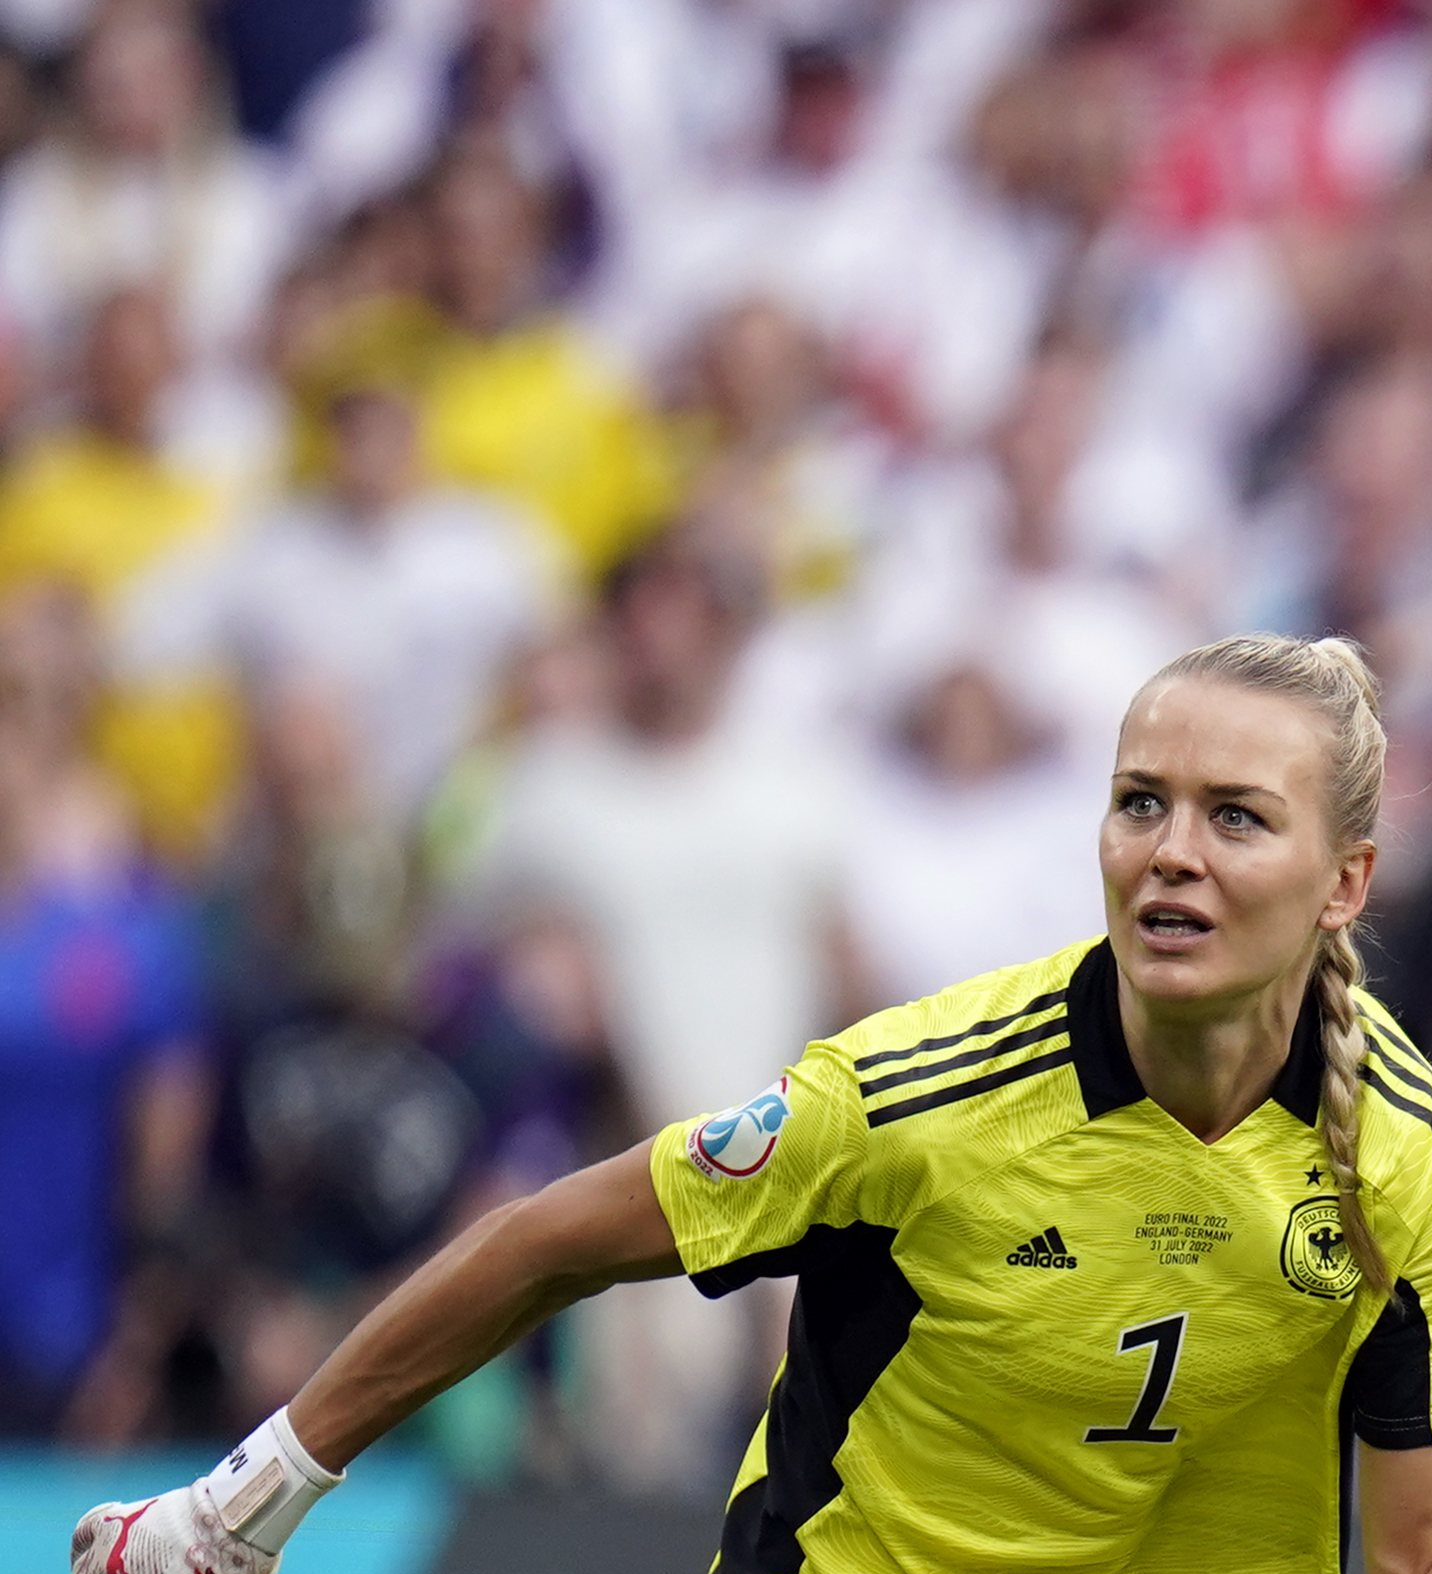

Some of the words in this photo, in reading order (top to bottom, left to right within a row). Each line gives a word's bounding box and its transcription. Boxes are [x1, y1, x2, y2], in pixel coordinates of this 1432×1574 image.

[690, 1150, 714, 1177] 2022
[1145, 1213, 1171, 1225] EURO
[1172, 1212, 1200, 1226] FINAL
[1203, 1215, 1228, 1229] 2022
[1150, 1240, 1161, 1251] 31
[1164, 1240, 1187, 1252] JULY
[1189, 1240, 1214, 1253] 2022
[1006, 1252, 1078, 1270] adidas
[1159, 1253, 1200, 1265] LONDON
[1081, 1311, 1189, 1444] 1
